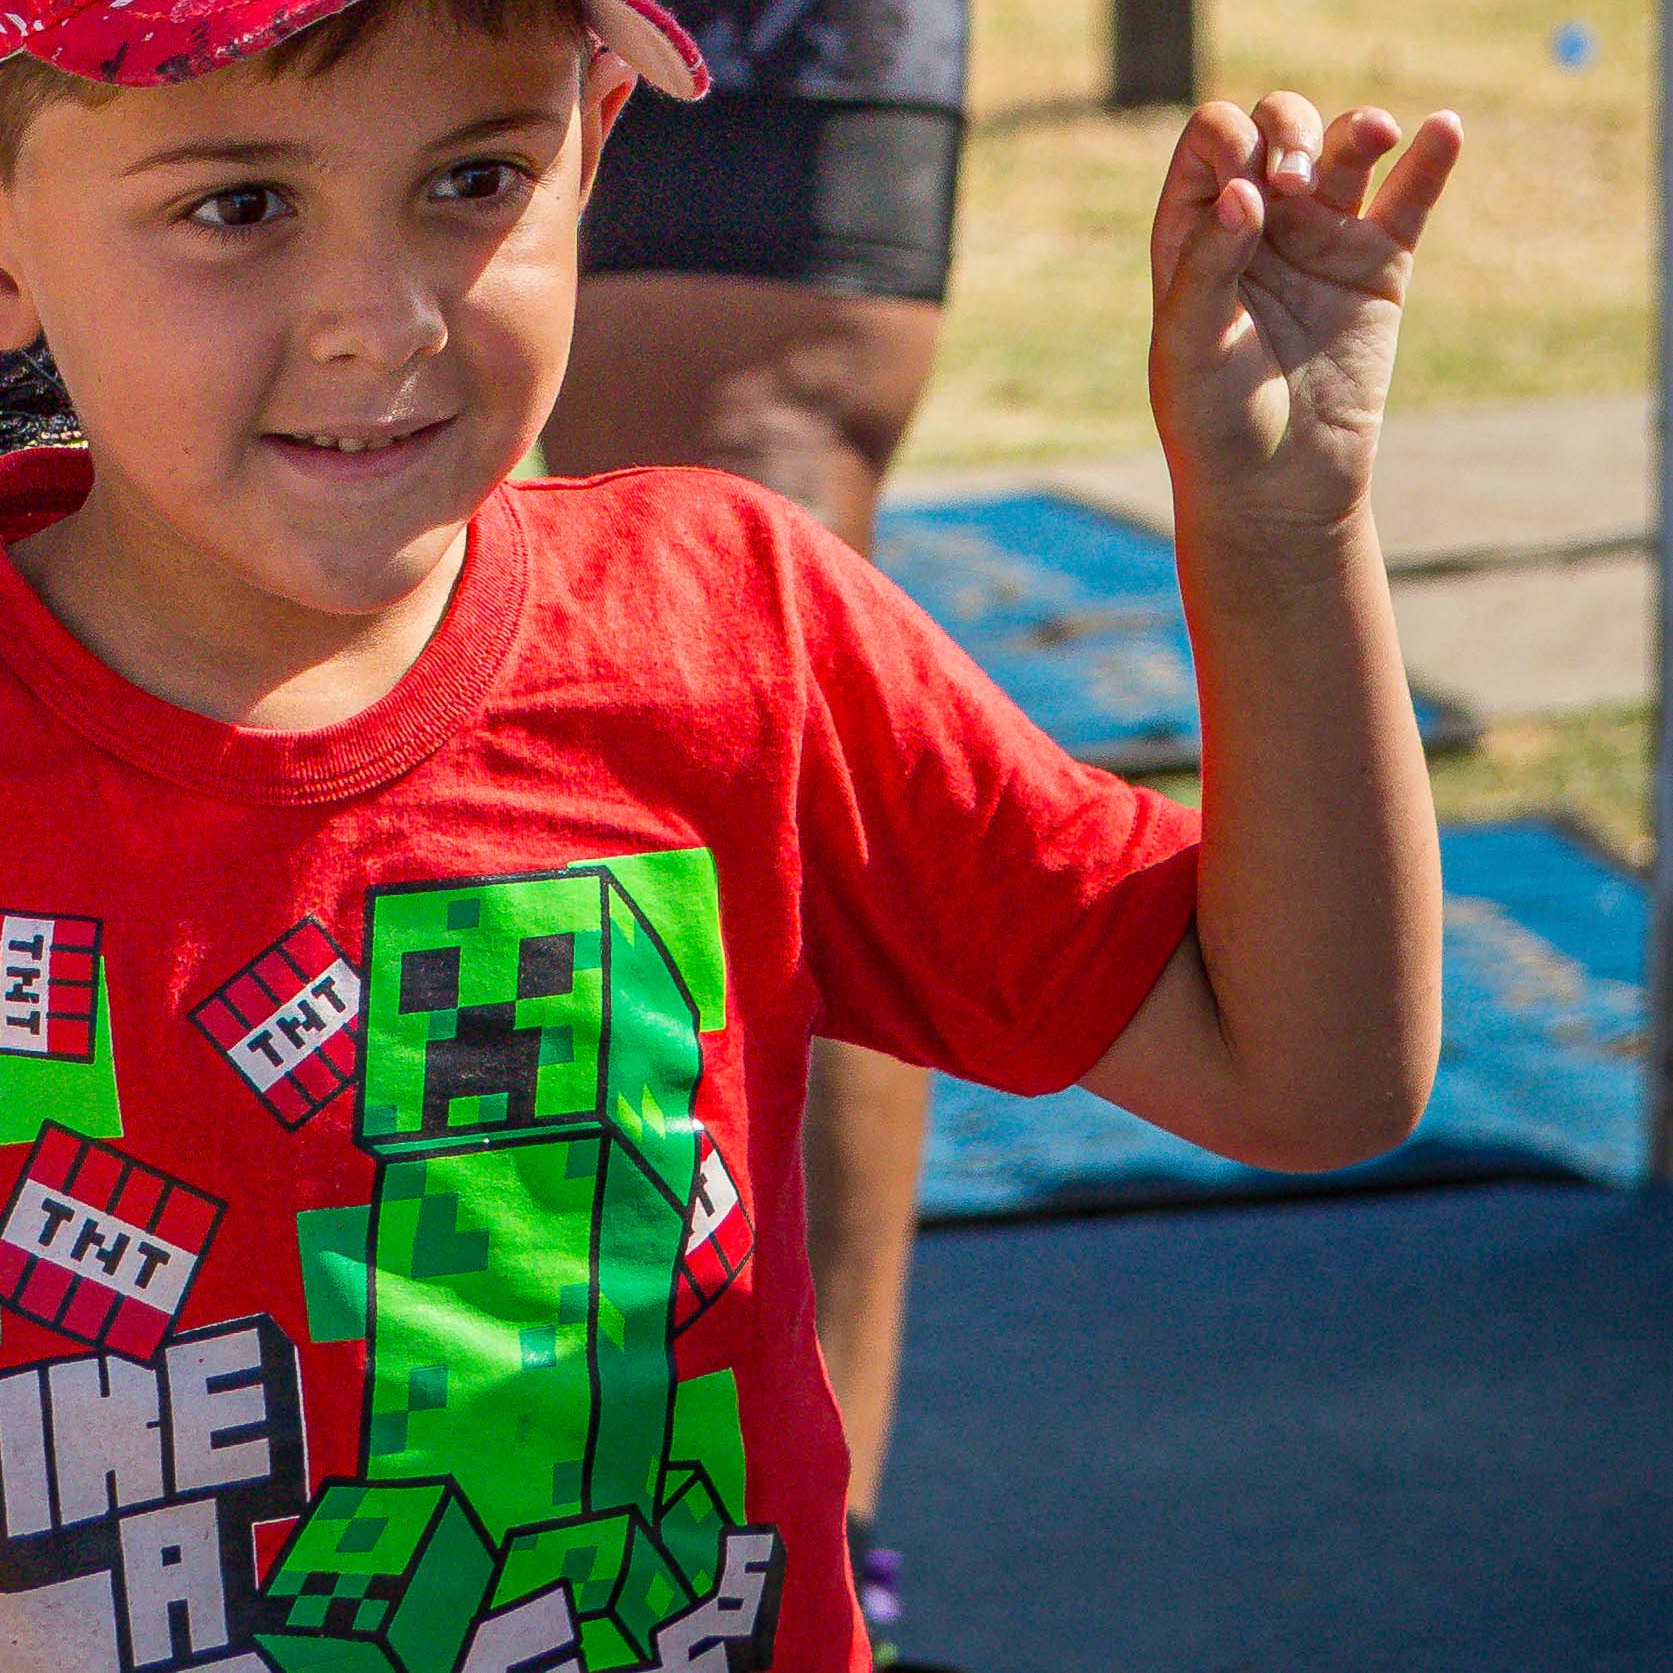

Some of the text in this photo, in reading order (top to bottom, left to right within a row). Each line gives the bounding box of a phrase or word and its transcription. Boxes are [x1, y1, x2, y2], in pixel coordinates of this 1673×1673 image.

[5, 934, 45, 1036] TNT
[246, 975, 347, 1068] TNT
[38, 1197, 171, 1290] TNT
[117, 1497, 230, 1668] A
